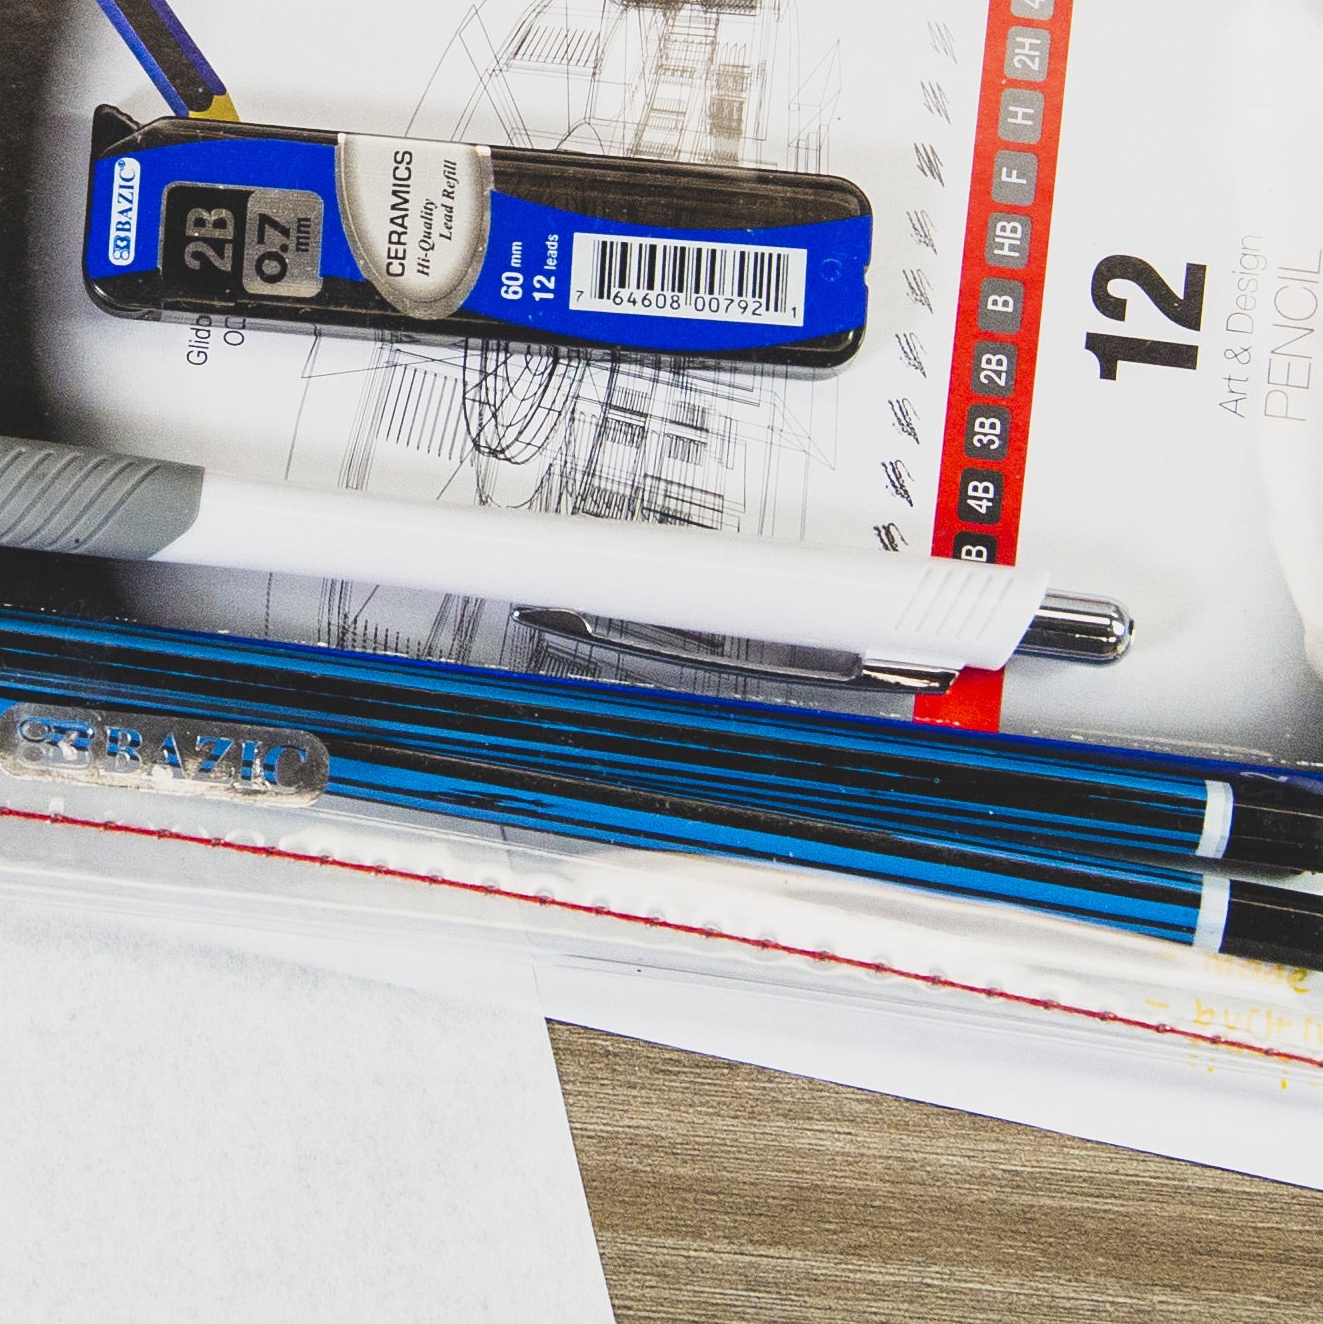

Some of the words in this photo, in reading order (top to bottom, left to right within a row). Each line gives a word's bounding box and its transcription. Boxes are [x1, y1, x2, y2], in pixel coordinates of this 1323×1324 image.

[1013, 36, 1042, 71] 2H
[1007, 105, 1035, 126] H
[442, 159, 460, 201] Refill
[1001, 166, 1028, 185] F
[115, 168, 136, 237] BAZIC
[386, 150, 413, 277] CERAMICS
[184, 207, 235, 272] 2B
[295, 217, 312, 253] mm
[416, 198, 438, 277] Hi-Quality
[439, 203, 455, 241] Lead
[993, 220, 1023, 258] HB
[254, 212, 292, 284] 0.7
[510, 241, 523, 268] mm
[543, 233, 559, 271] leads
[500, 271, 524, 300] 60
[532, 274, 556, 303] 12
[987, 293, 1015, 313] B
[1225, 235, 1268, 334] Design
[575, 290, 585, 303] 7
[611, 291, 682, 310] 64608
[694, 295, 764, 317] 00792
[1084, 254, 1208, 381] 12
[1264, 248, 1323, 421] PENCIL
[979, 352, 1008, 388] 2B
[1223, 345, 1252, 366] &
[1218, 374, 1250, 419] Art
[972, 416, 1002, 450] 3B
[966, 479, 995, 514] 4B
[961, 545, 988, 562] B
[104, 726, 309, 796] BAZIC
